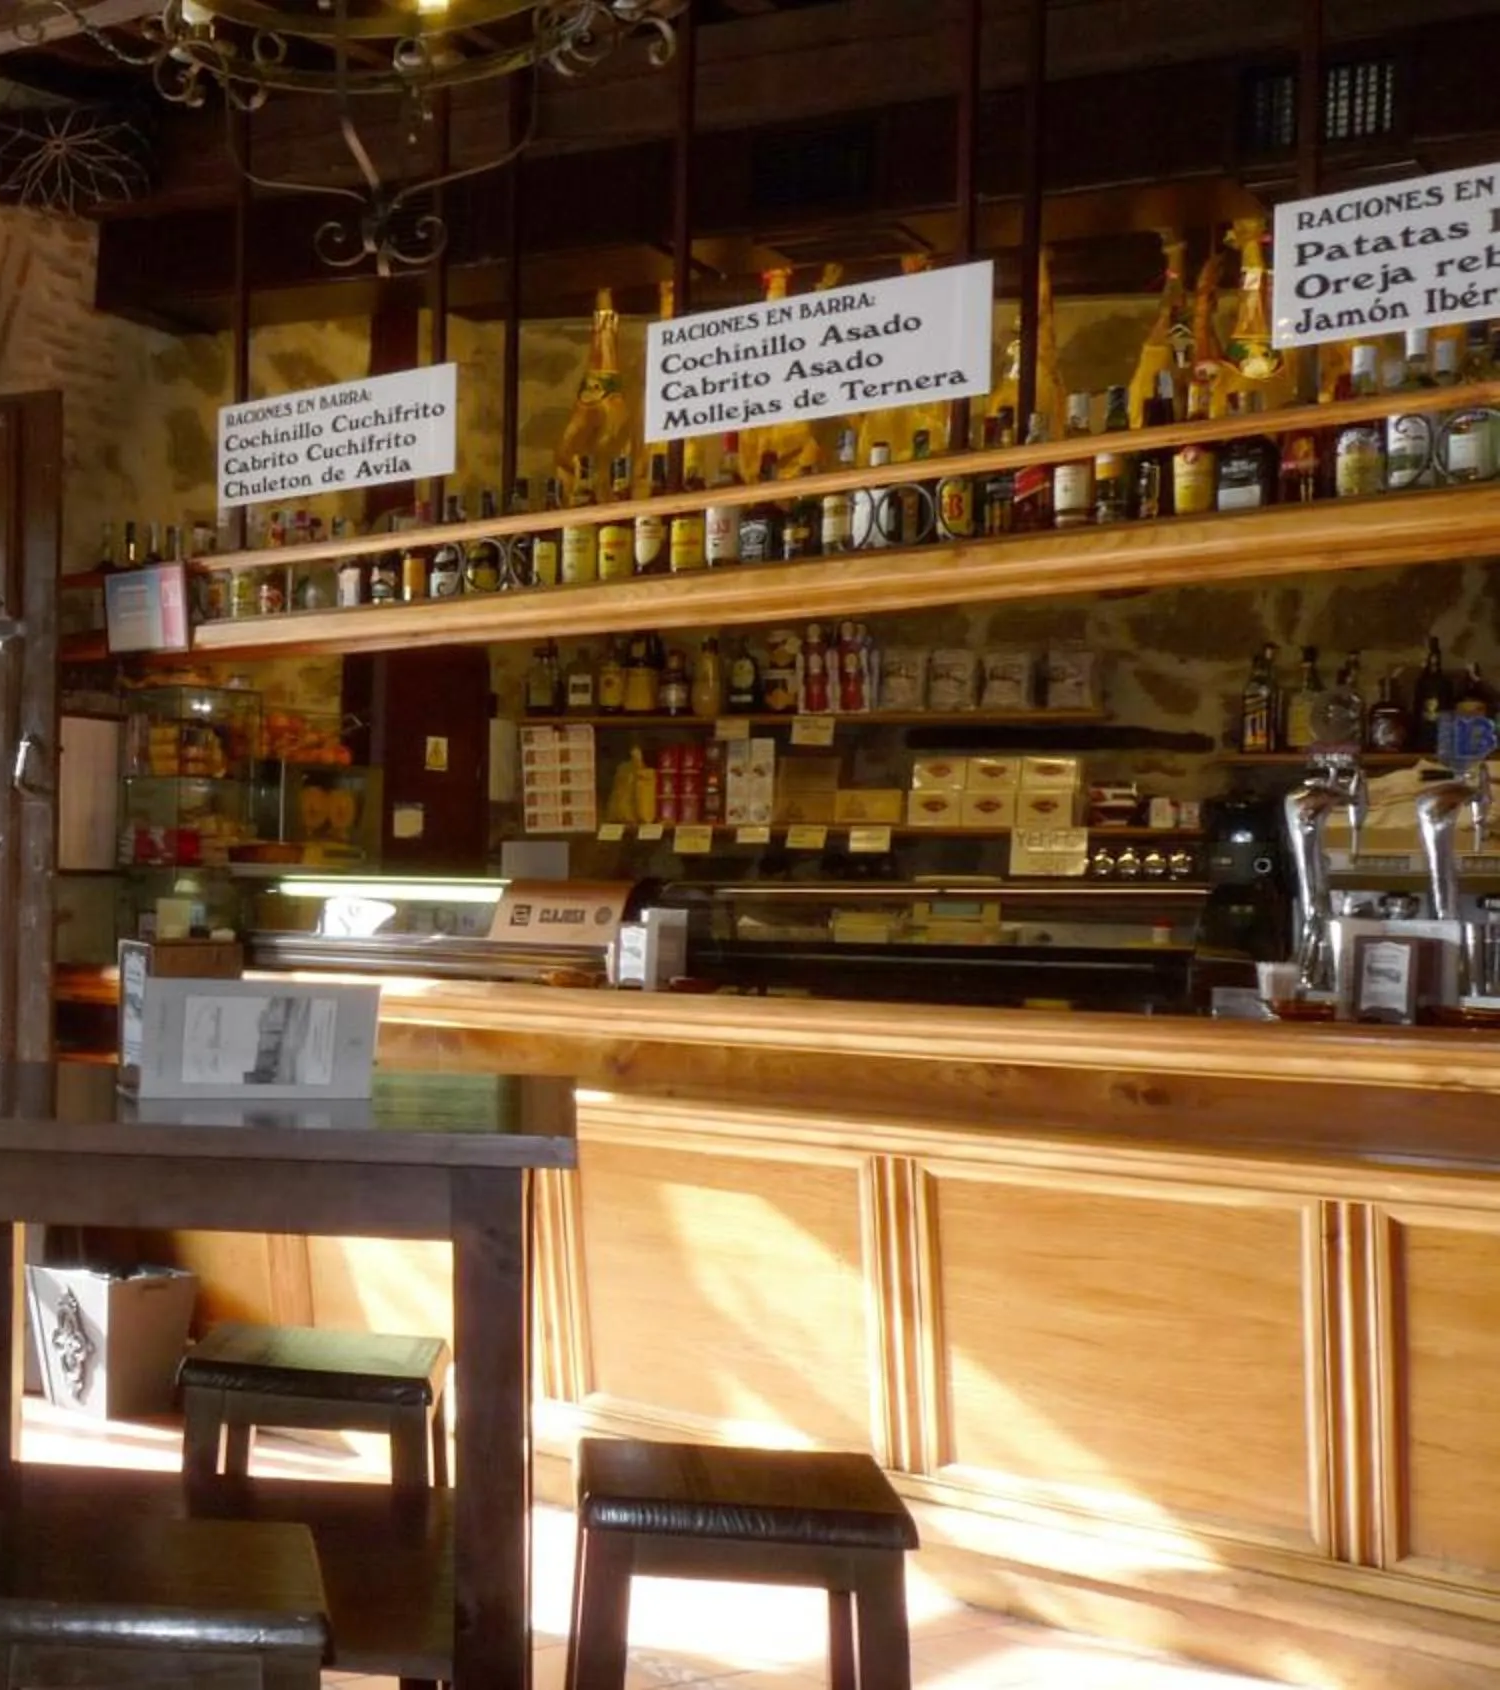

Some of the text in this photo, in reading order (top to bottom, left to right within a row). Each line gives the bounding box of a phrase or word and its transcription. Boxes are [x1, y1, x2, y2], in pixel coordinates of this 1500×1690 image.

[1296, 175, 1496, 232] RACIONES EN
[1294, 221, 1471, 268] Patatas
[1294, 263, 1418, 301] Oreja
[661, 291, 876, 347] RACIONES EN BARRA:
[1294, 297, 1410, 335] Jamón
[660, 312, 923, 376] Cochinillo Asado
[660, 350, 884, 403] Cabrito Asado
[661, 367, 969, 432] Mollejas de Ternera
[224, 401, 446, 453] Cochinillo Cuchifrito
[225, 402, 293, 428] RACIONES
[296, 398, 316, 415] EN
[224, 430, 417, 476] Cabrito Cuchifrito
[224, 456, 412, 500] Chuleton de Avila
